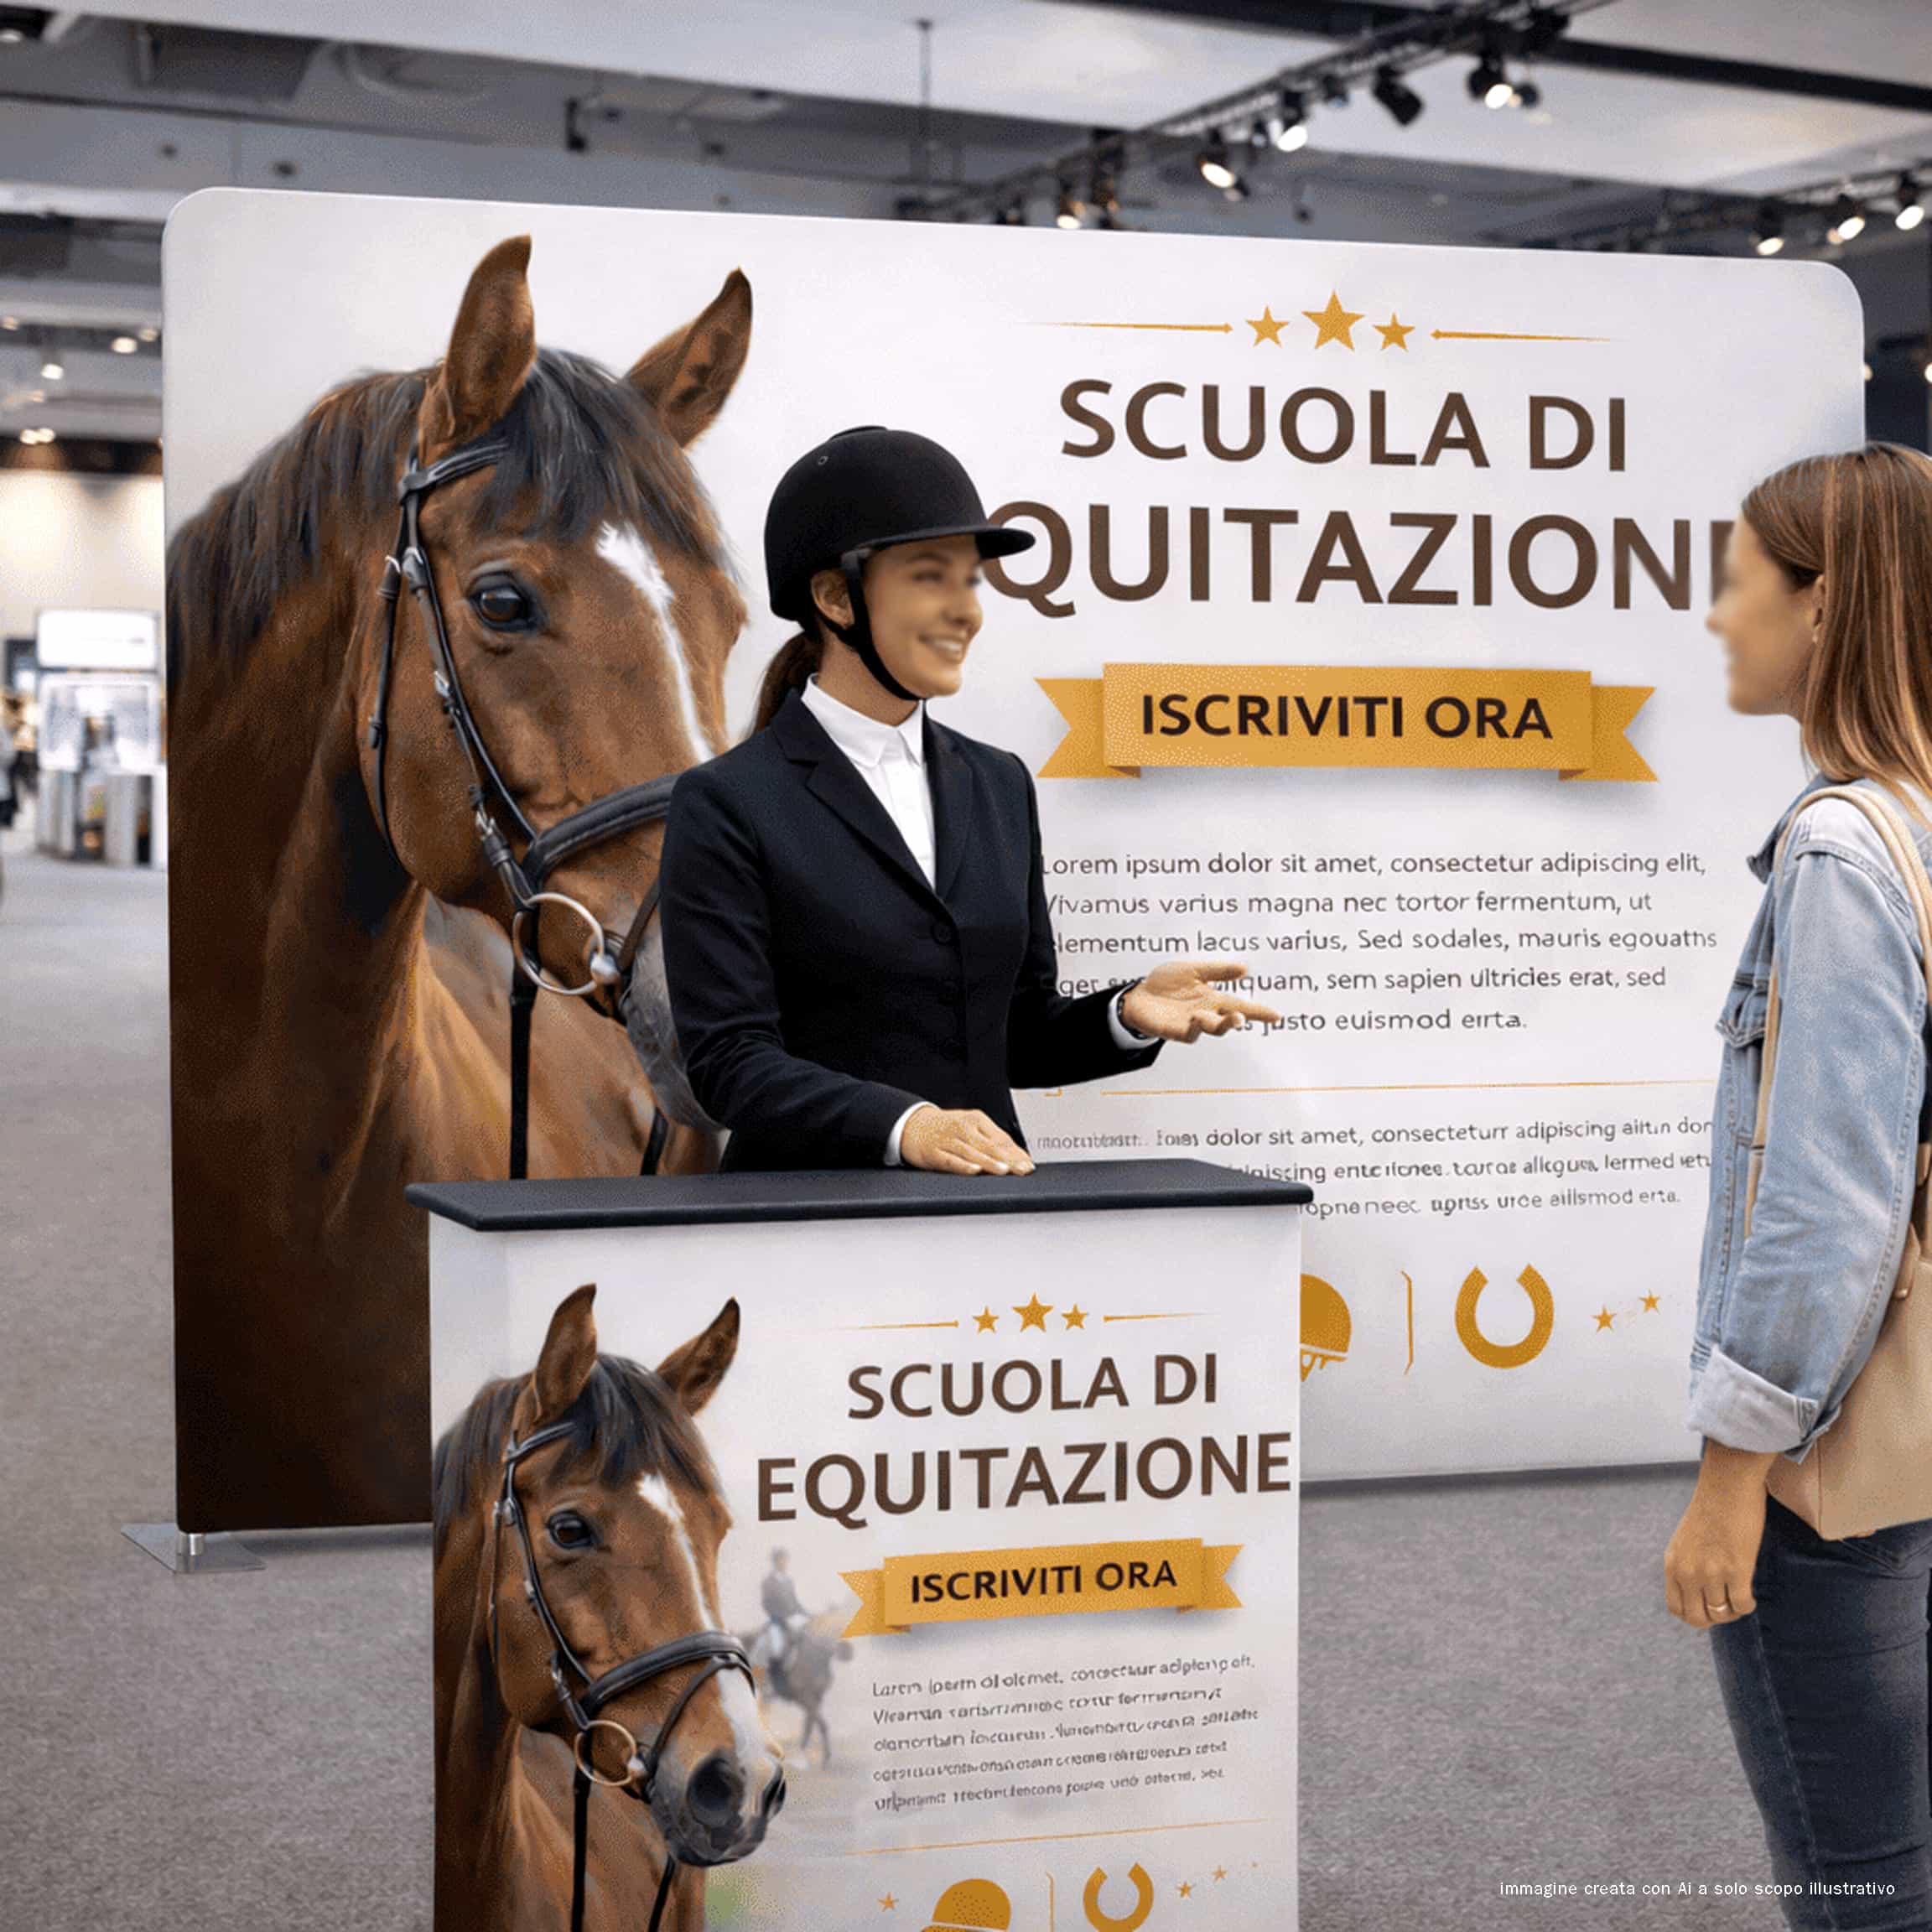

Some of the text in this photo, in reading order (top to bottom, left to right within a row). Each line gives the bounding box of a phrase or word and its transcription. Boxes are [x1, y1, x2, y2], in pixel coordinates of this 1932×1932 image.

[1061, 379, 1625, 471] SCUOLA DI
[988, 500, 1734, 619] QUITAZION
[1142, 693, 1554, 740] ISCRIVITI ORA
[1126, 854, 1201, 879] ipsum
[1208, 852, 1271, 874] dolor
[1280, 854, 1308, 873] sit
[1314, 855, 1382, 876] amet,
[1390, 854, 1533, 874] consectetur
[1540, 852, 1659, 877] adipiscing
[1666, 852, 1706, 875] elit,
[1159, 894, 1239, 914] varius
[1248, 895, 1333, 917] magna
[1343, 894, 1387, 912] nec
[1396, 893, 1469, 912] tortor
[1476, 891, 1622, 915] fermentum,
[1629, 894, 1653, 911] ut
[1056, 932, 1189, 954] lementum
[1197, 931, 1259, 953] lacus
[1266, 932, 1347, 953] varius,
[1358, 929, 1402, 949] Sed
[1412, 928, 1509, 953] sodales,
[1519, 928, 1602, 948] mauris
[1327, 973, 1377, 991] sem
[1384, 969, 1462, 993] sapien
[1470, 968, 1561, 988] ultricies
[1569, 968, 1620, 989] erat,
[1626, 967, 1666, 987] sed
[1335, 1009, 1452, 1031] euismod
[1206, 1128, 1261, 1146] dolor
[1268, 1128, 1294, 1145] sit
[1300, 1127, 1365, 1148] amet,
[1516, 1119, 1616, 1143] adipiscing
[849, 1353, 1216, 1420] SCUOLA DI
[758, 1432, 1291, 1530] EQUITAZIONE
[911, 1560, 1178, 1604] ISCRIVITI ORA
